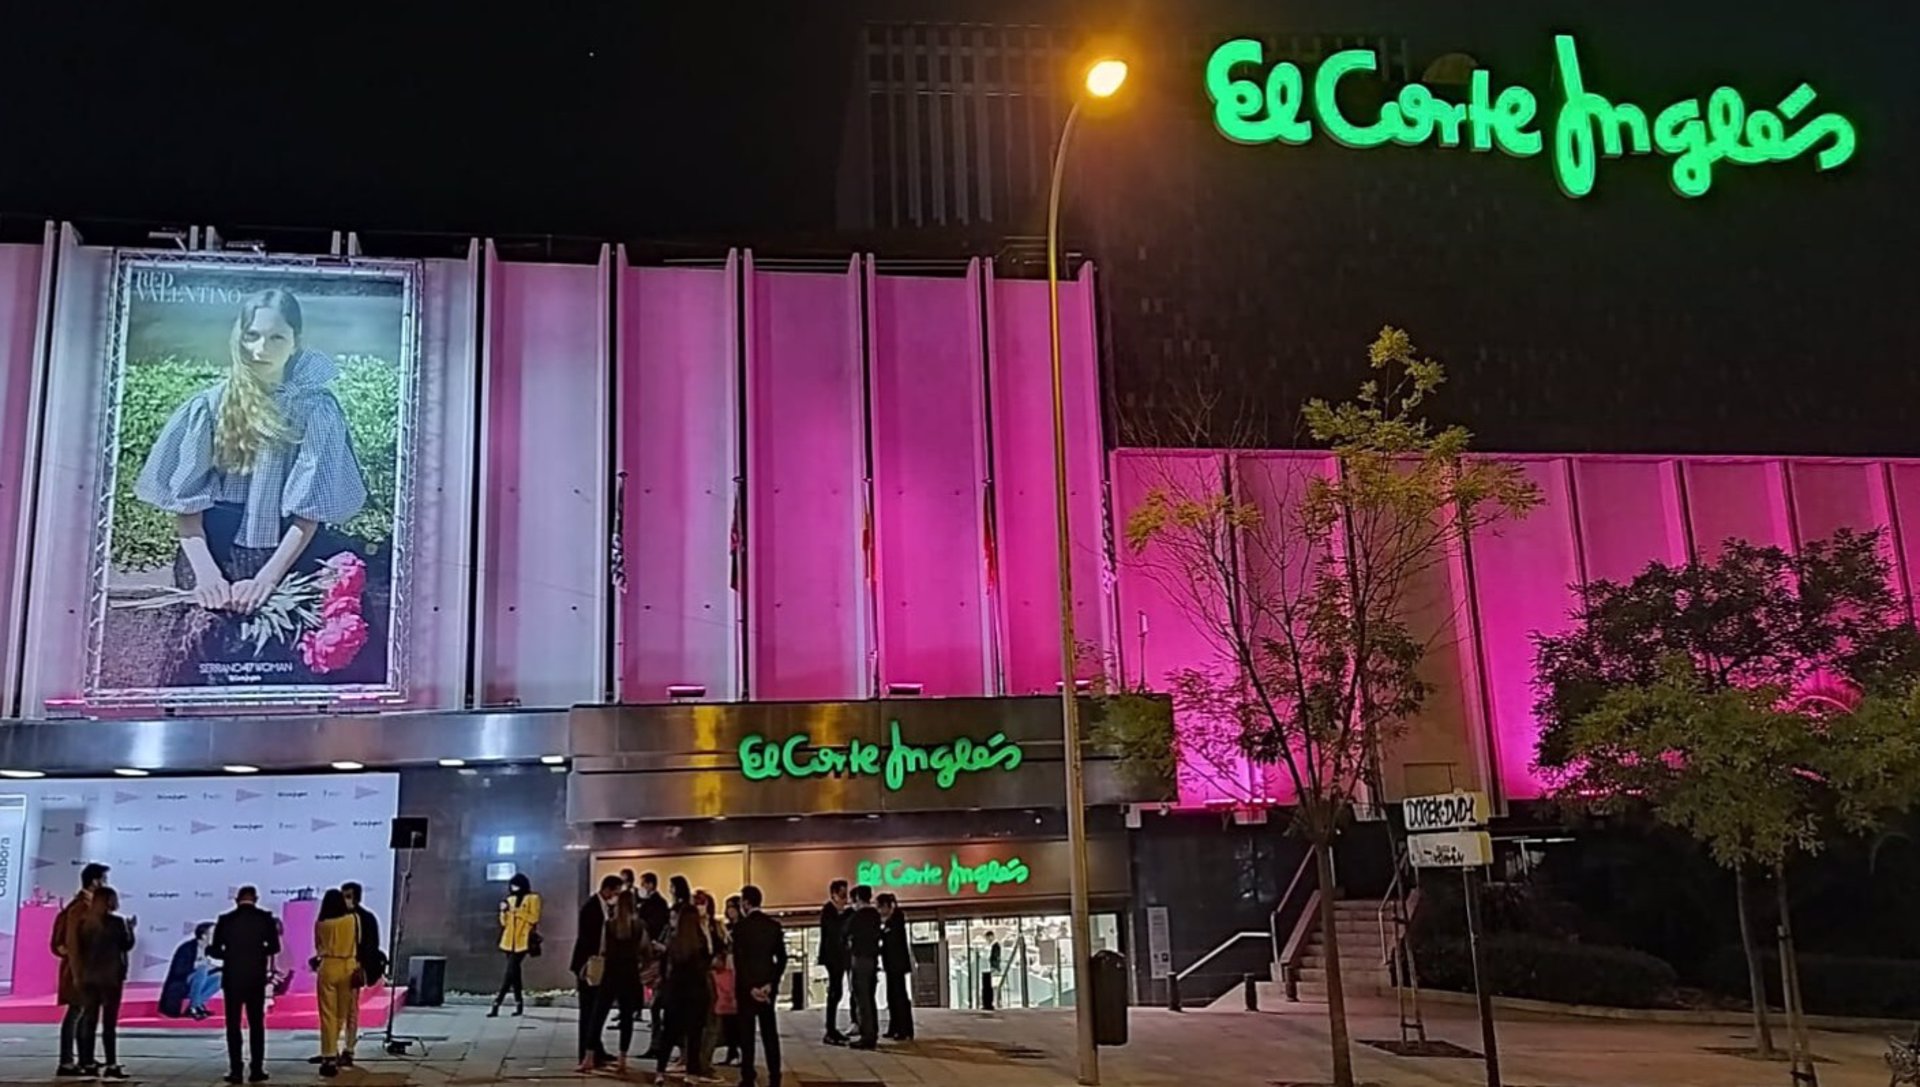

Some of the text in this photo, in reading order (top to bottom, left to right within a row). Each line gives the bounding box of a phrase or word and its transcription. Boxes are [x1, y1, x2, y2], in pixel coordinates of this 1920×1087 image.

[1206, 35, 1857, 197] El Corte Inglés
[136, 271, 174, 288] RED
[137, 286, 241, 303] VALENTINO
[738, 720, 1022, 790] El Corte Inglés
[857, 854, 1029, 894] El Corte Inglés
